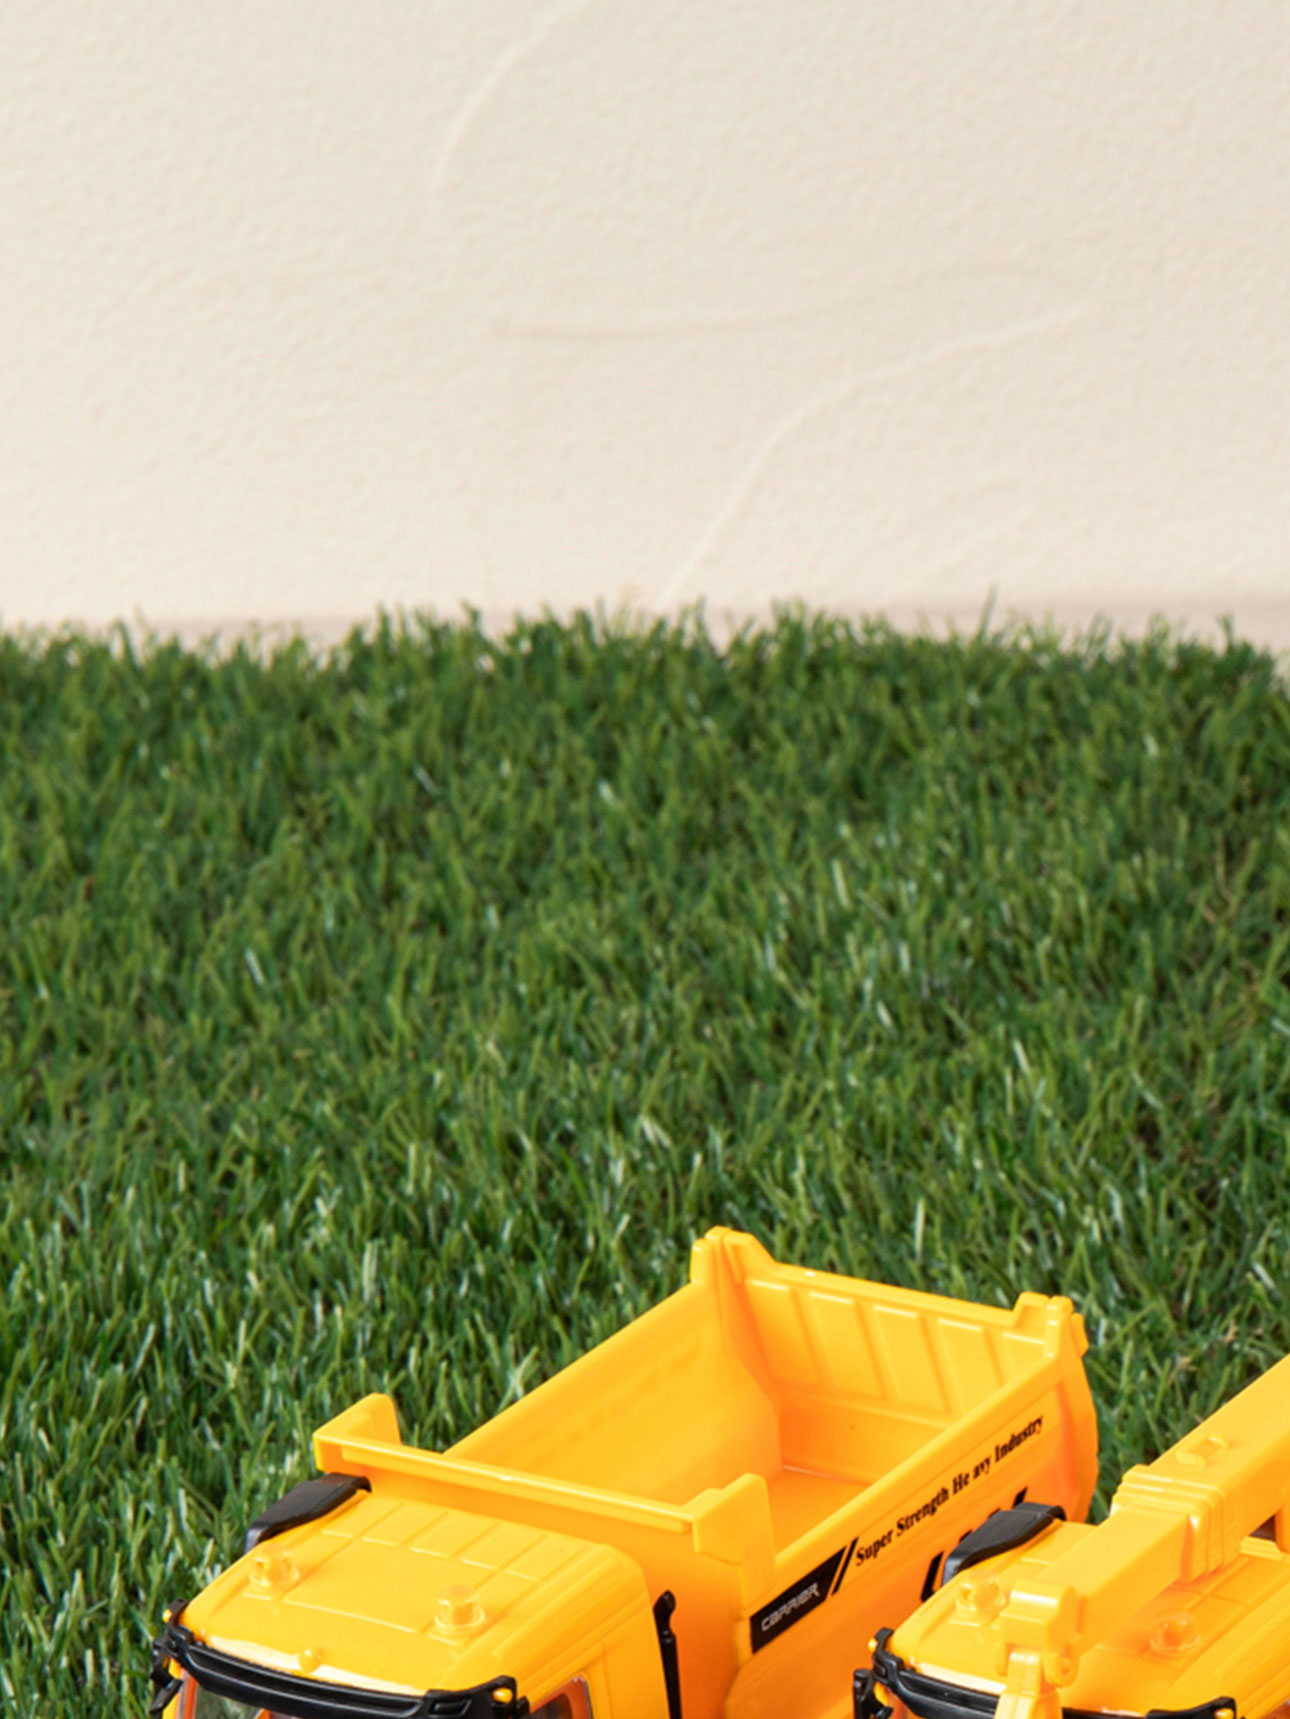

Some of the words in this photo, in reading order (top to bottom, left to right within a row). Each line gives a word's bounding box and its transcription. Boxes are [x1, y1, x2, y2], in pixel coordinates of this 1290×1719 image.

[856, 1529, 893, 1566] Super
[896, 1486, 949, 1537] Strength
[994, 1415, 1043, 1464] Industry
